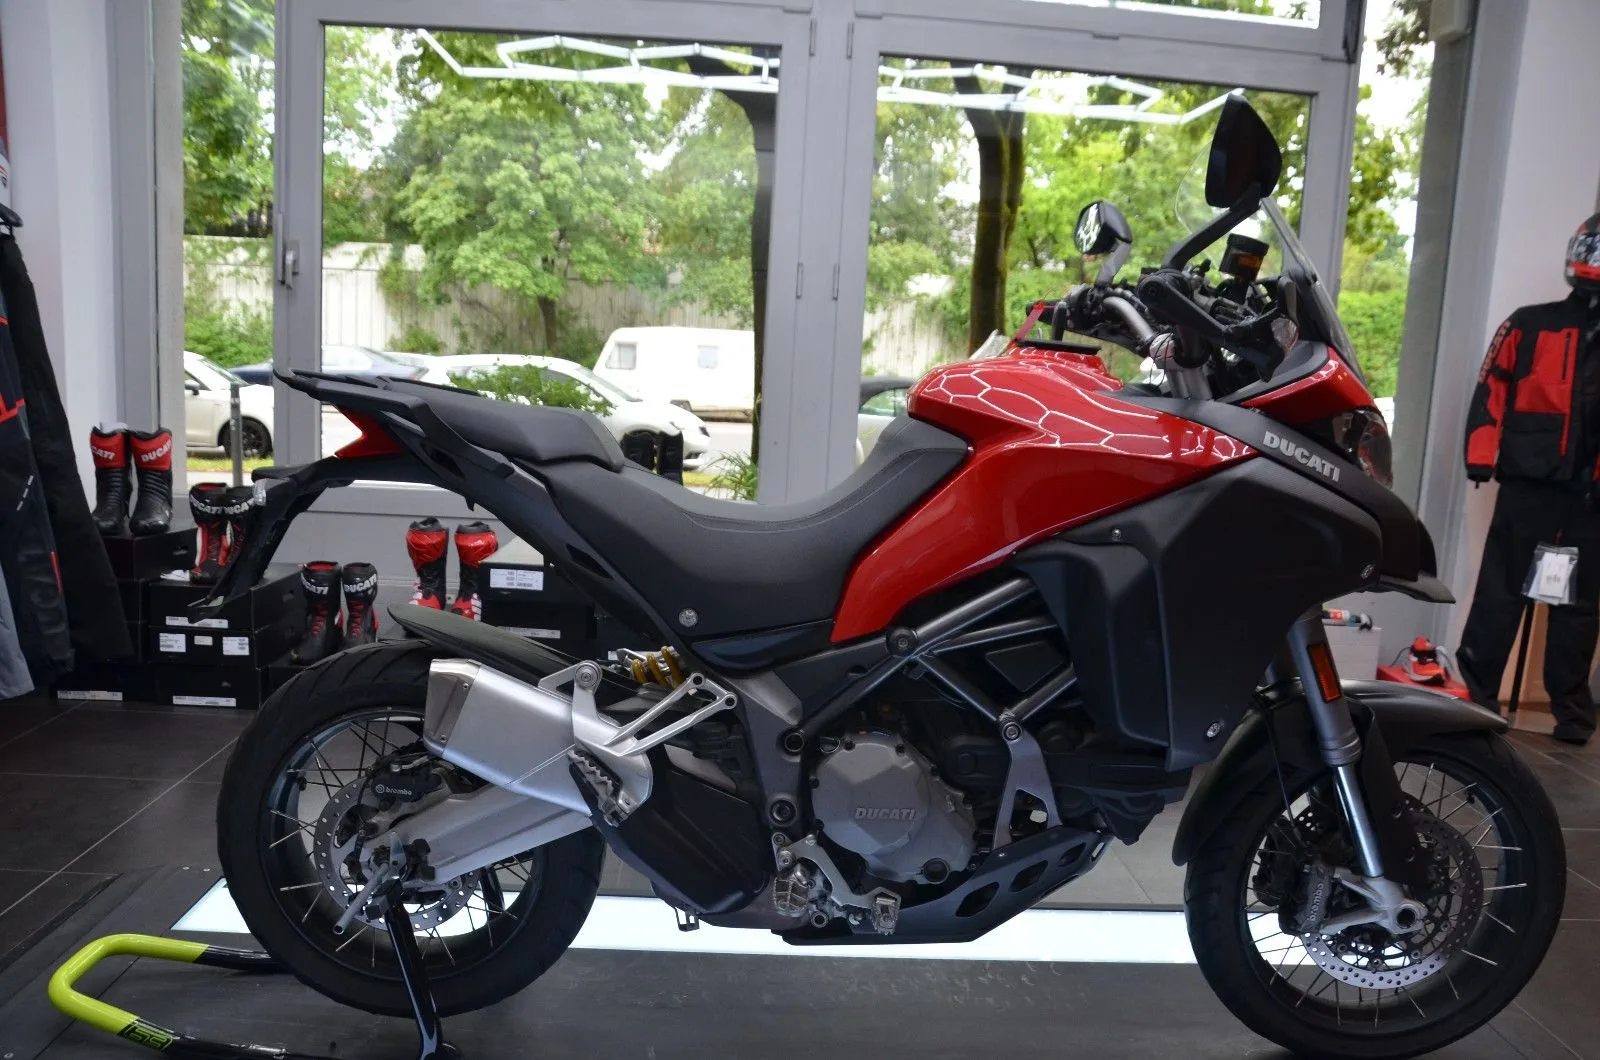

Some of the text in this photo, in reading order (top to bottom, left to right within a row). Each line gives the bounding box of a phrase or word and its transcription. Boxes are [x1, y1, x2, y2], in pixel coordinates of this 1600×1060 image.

[1263, 431, 1340, 482] DUCATI
[385, 786, 413, 796] brembo
[854, 807, 916, 820] DUCATI
[1306, 883, 1324, 921] brembo
